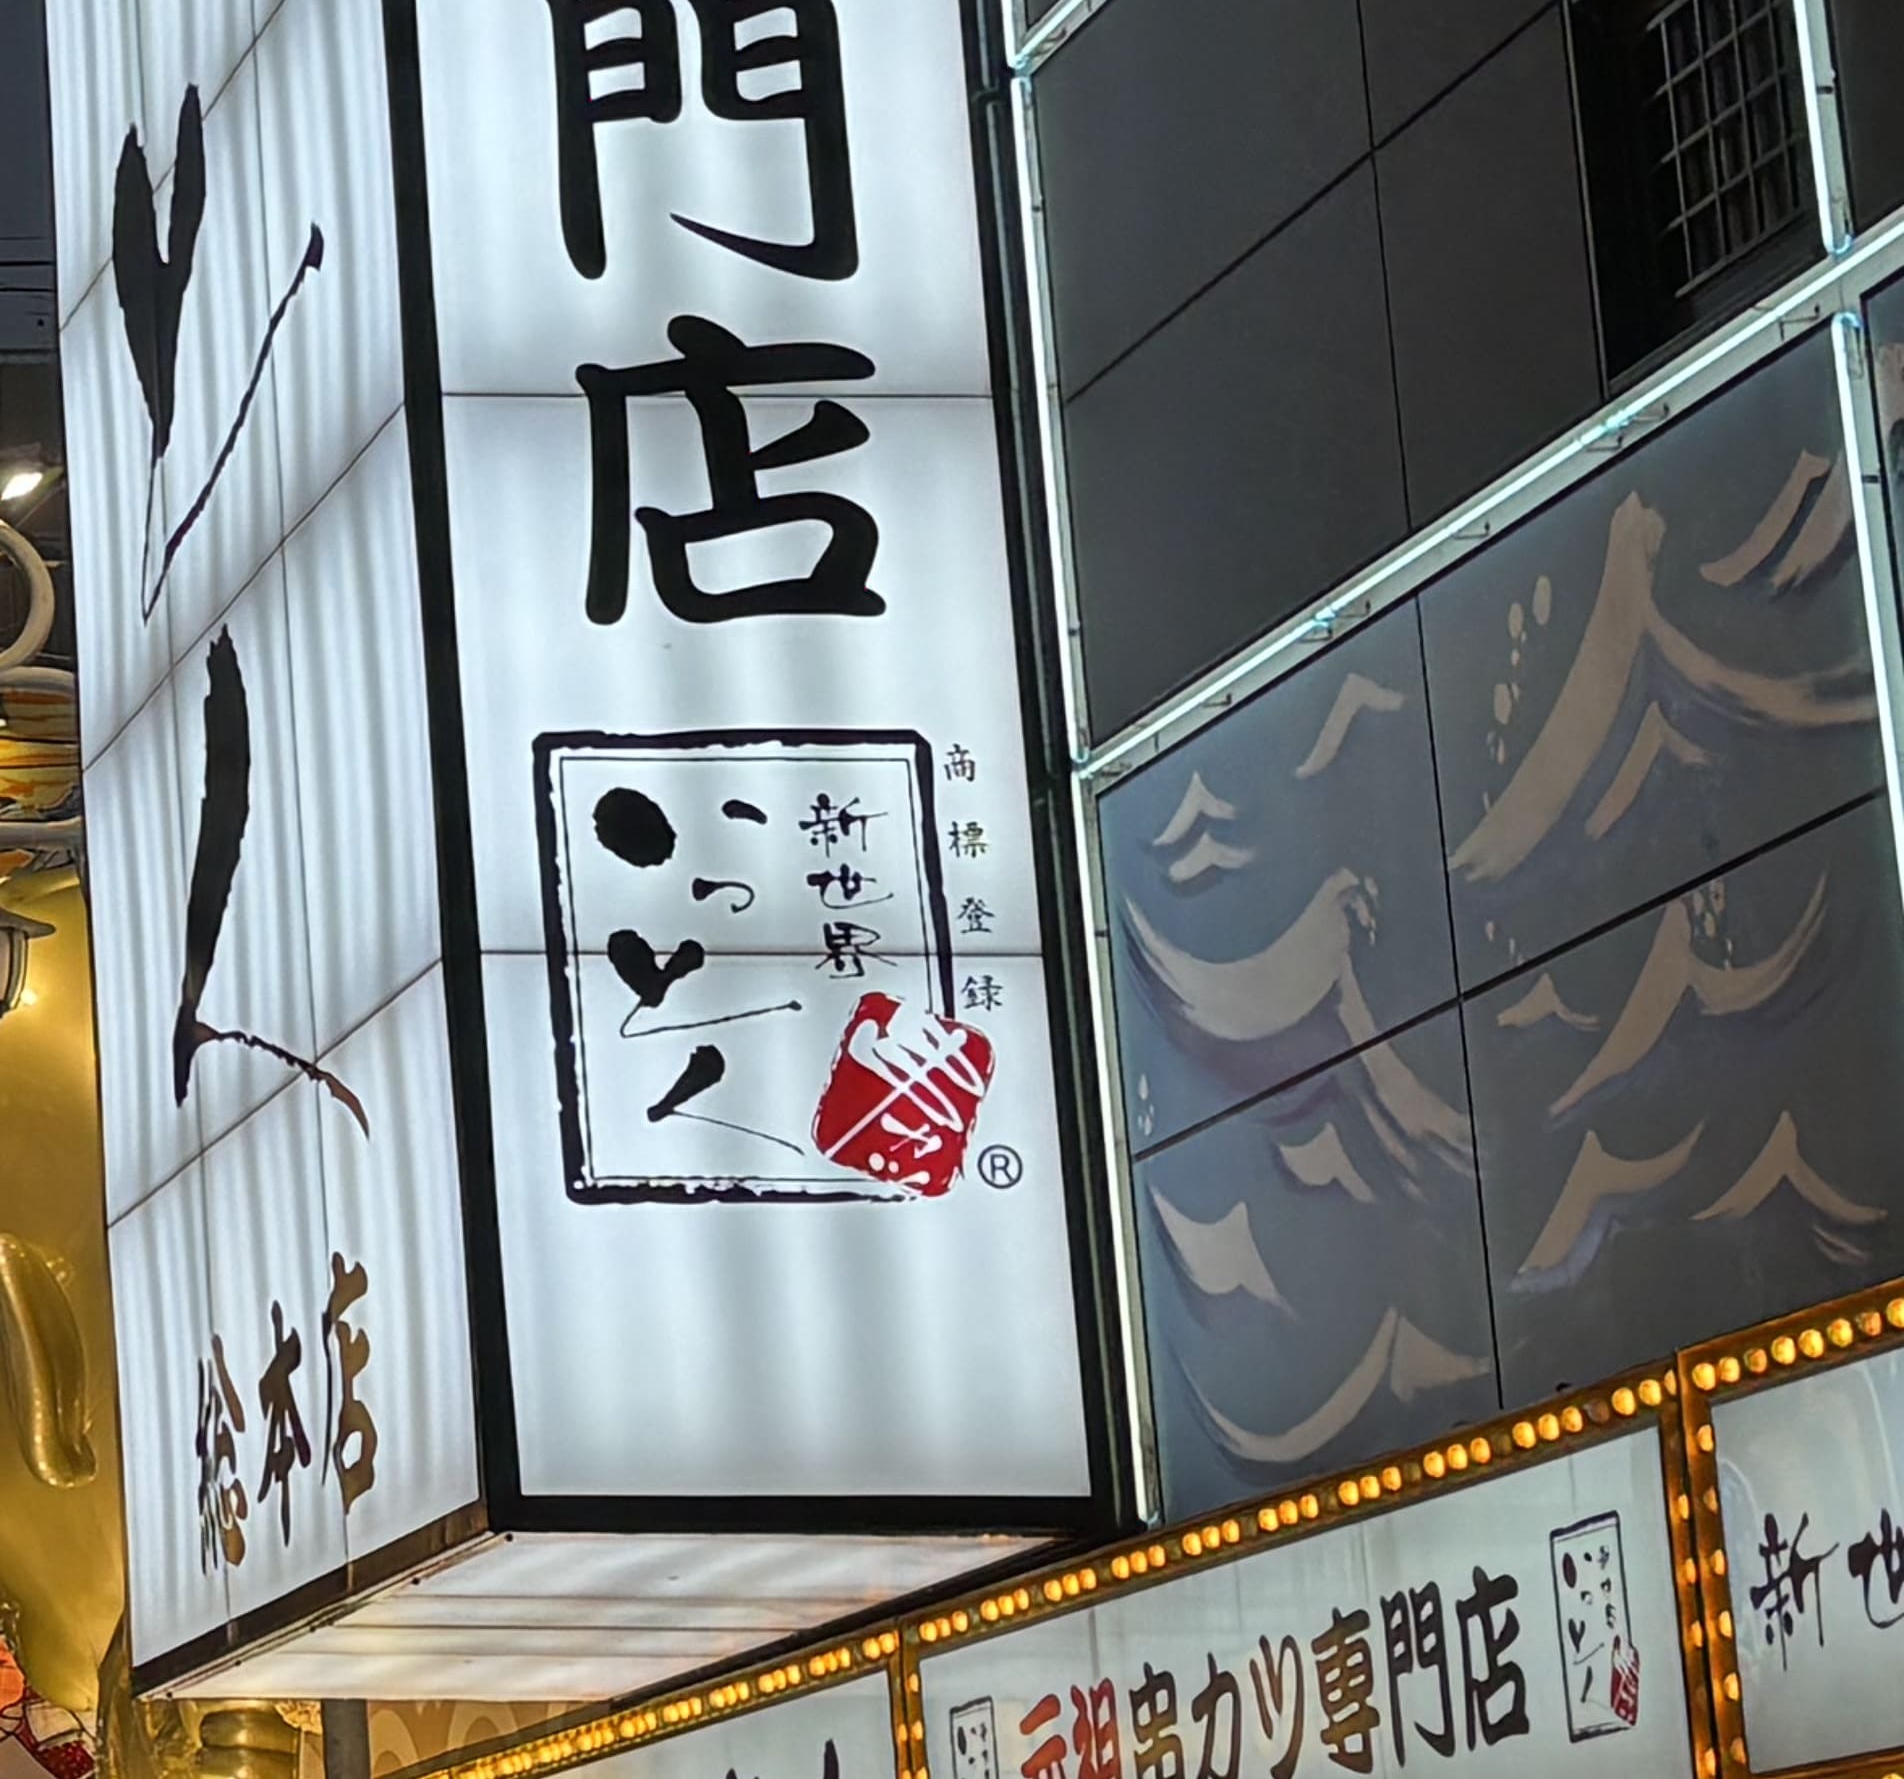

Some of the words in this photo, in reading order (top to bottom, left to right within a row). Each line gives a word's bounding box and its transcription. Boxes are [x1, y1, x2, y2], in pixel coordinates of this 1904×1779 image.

[798, 793, 897, 979] 新世界
[942, 743, 1004, 1010] 商標登録
[195, 1251, 378, 1575] 総本店
[1020, 1564, 1531, 1779] 元祖串カツ専門店
